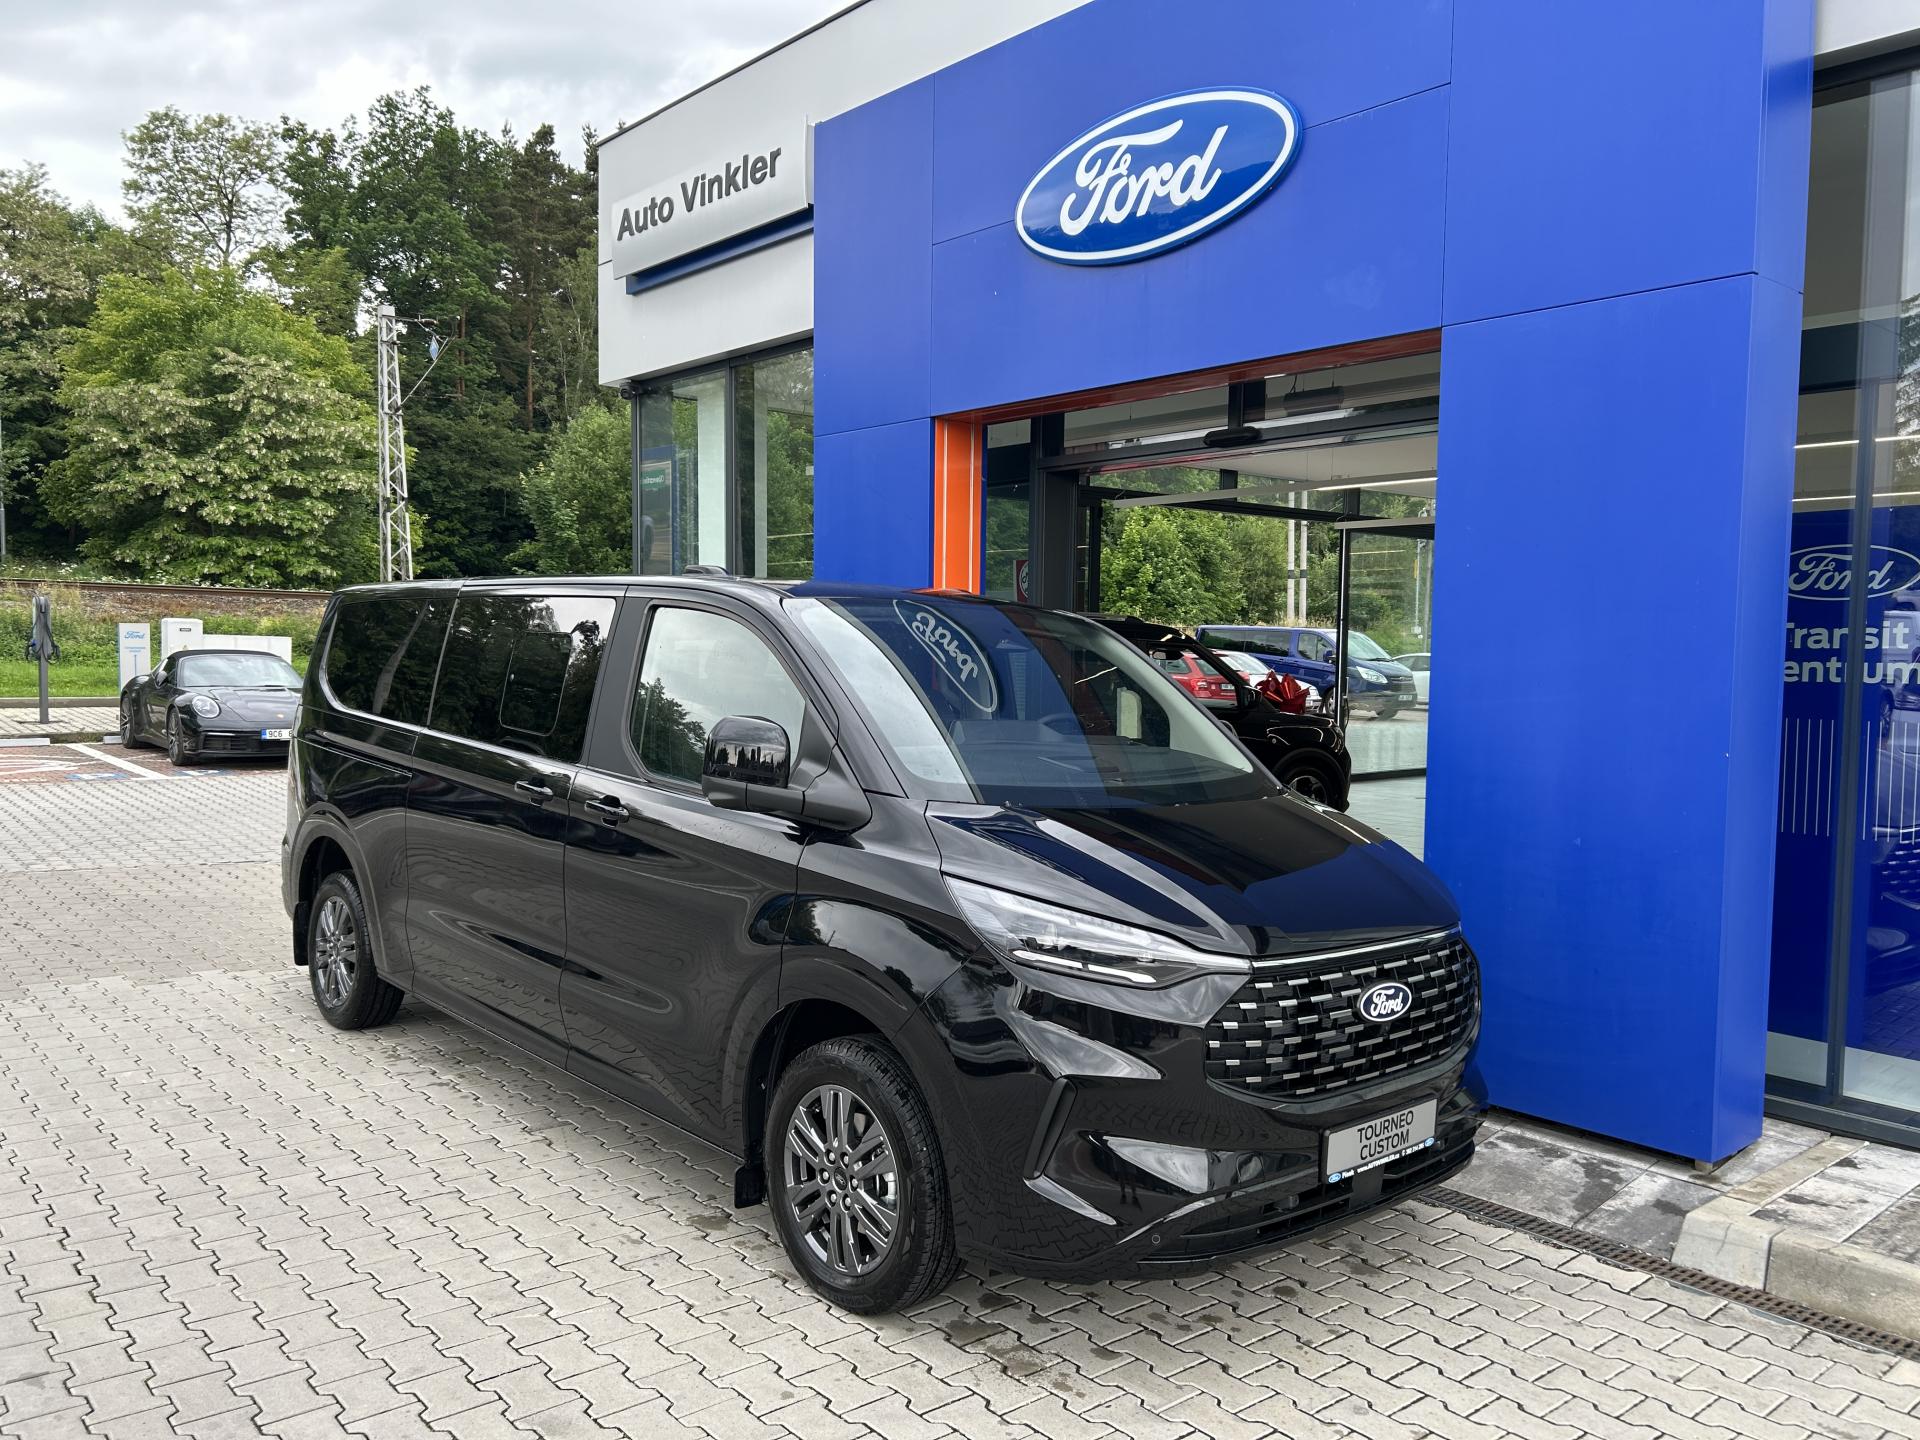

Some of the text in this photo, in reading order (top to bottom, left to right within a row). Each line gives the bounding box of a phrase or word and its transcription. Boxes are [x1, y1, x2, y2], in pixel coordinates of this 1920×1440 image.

[1059, 118, 1229, 237] Ford
[617, 147, 782, 242] Auto Vinkler
[1370, 988, 1403, 1017] Ford
[1357, 1110, 1414, 1143] TOURNEO
[1360, 1129, 1410, 1161] CUSTOM
